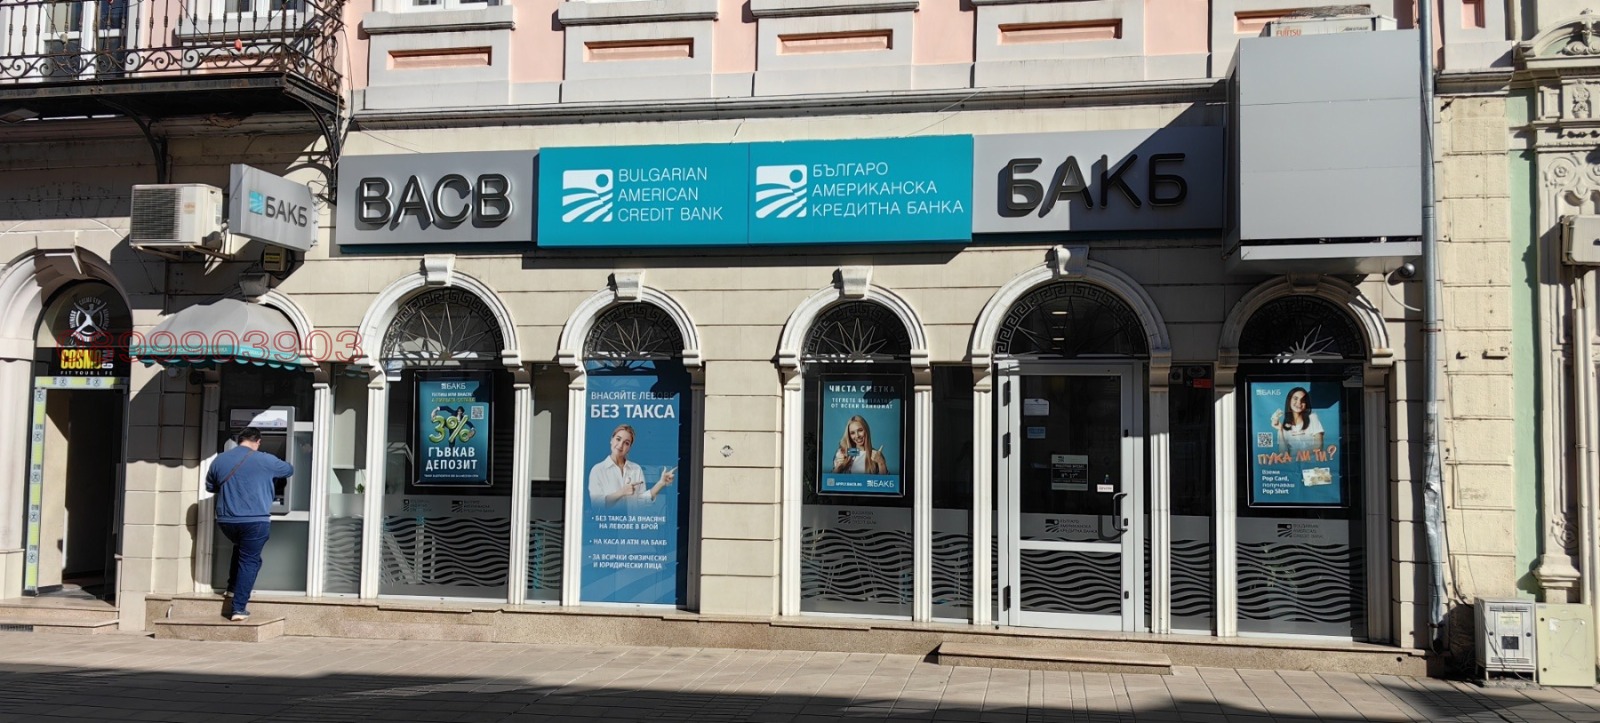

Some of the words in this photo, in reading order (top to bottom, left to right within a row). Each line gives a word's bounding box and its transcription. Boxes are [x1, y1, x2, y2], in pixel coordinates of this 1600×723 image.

[1276, 26, 1302, 37] FUJITSU
[618, 167, 708, 182] BULGARIAN
[812, 162, 889, 178] БЪЛГАРО
[1007, 153, 1188, 209] БАКБ
[617, 187, 699, 202] AMERICAN
[811, 180, 938, 198] АМЕРИКАНСКА
[359, 173, 513, 224] BACB
[265, 195, 308, 228] БАКБ
[617, 208, 675, 222] CREDIT
[680, 206, 723, 221] BANK
[812, 201, 901, 218] КРЕДИТНА
[906, 200, 964, 215] БАНКА
[60, 349, 102, 369] COSMO
[446, 382, 466, 390] БАКБ
[829, 384, 857, 392] ЧИСТА
[591, 390, 637, 400] ВНАСЯЙТЕ
[639, 391, 675, 400] ЛЕВОВЕ
[590, 404, 620, 418] БЕЗ
[624, 404, 676, 418] ТАКСА
[429, 415, 470, 443] 3%
[428, 446, 476, 458] ГЪВКАВ
[1257, 452, 1292, 466] ПУКА
[1295, 450, 1310, 462] ЛИ
[425, 459, 478, 472] ДЕПОЗИТ
[873, 480, 895, 488] БАКБ
[637, 515, 667, 523] ВНАСЯНЕ
[640, 522, 659, 530] БРОЙ
[644, 562, 663, 570] ЛИЦА
